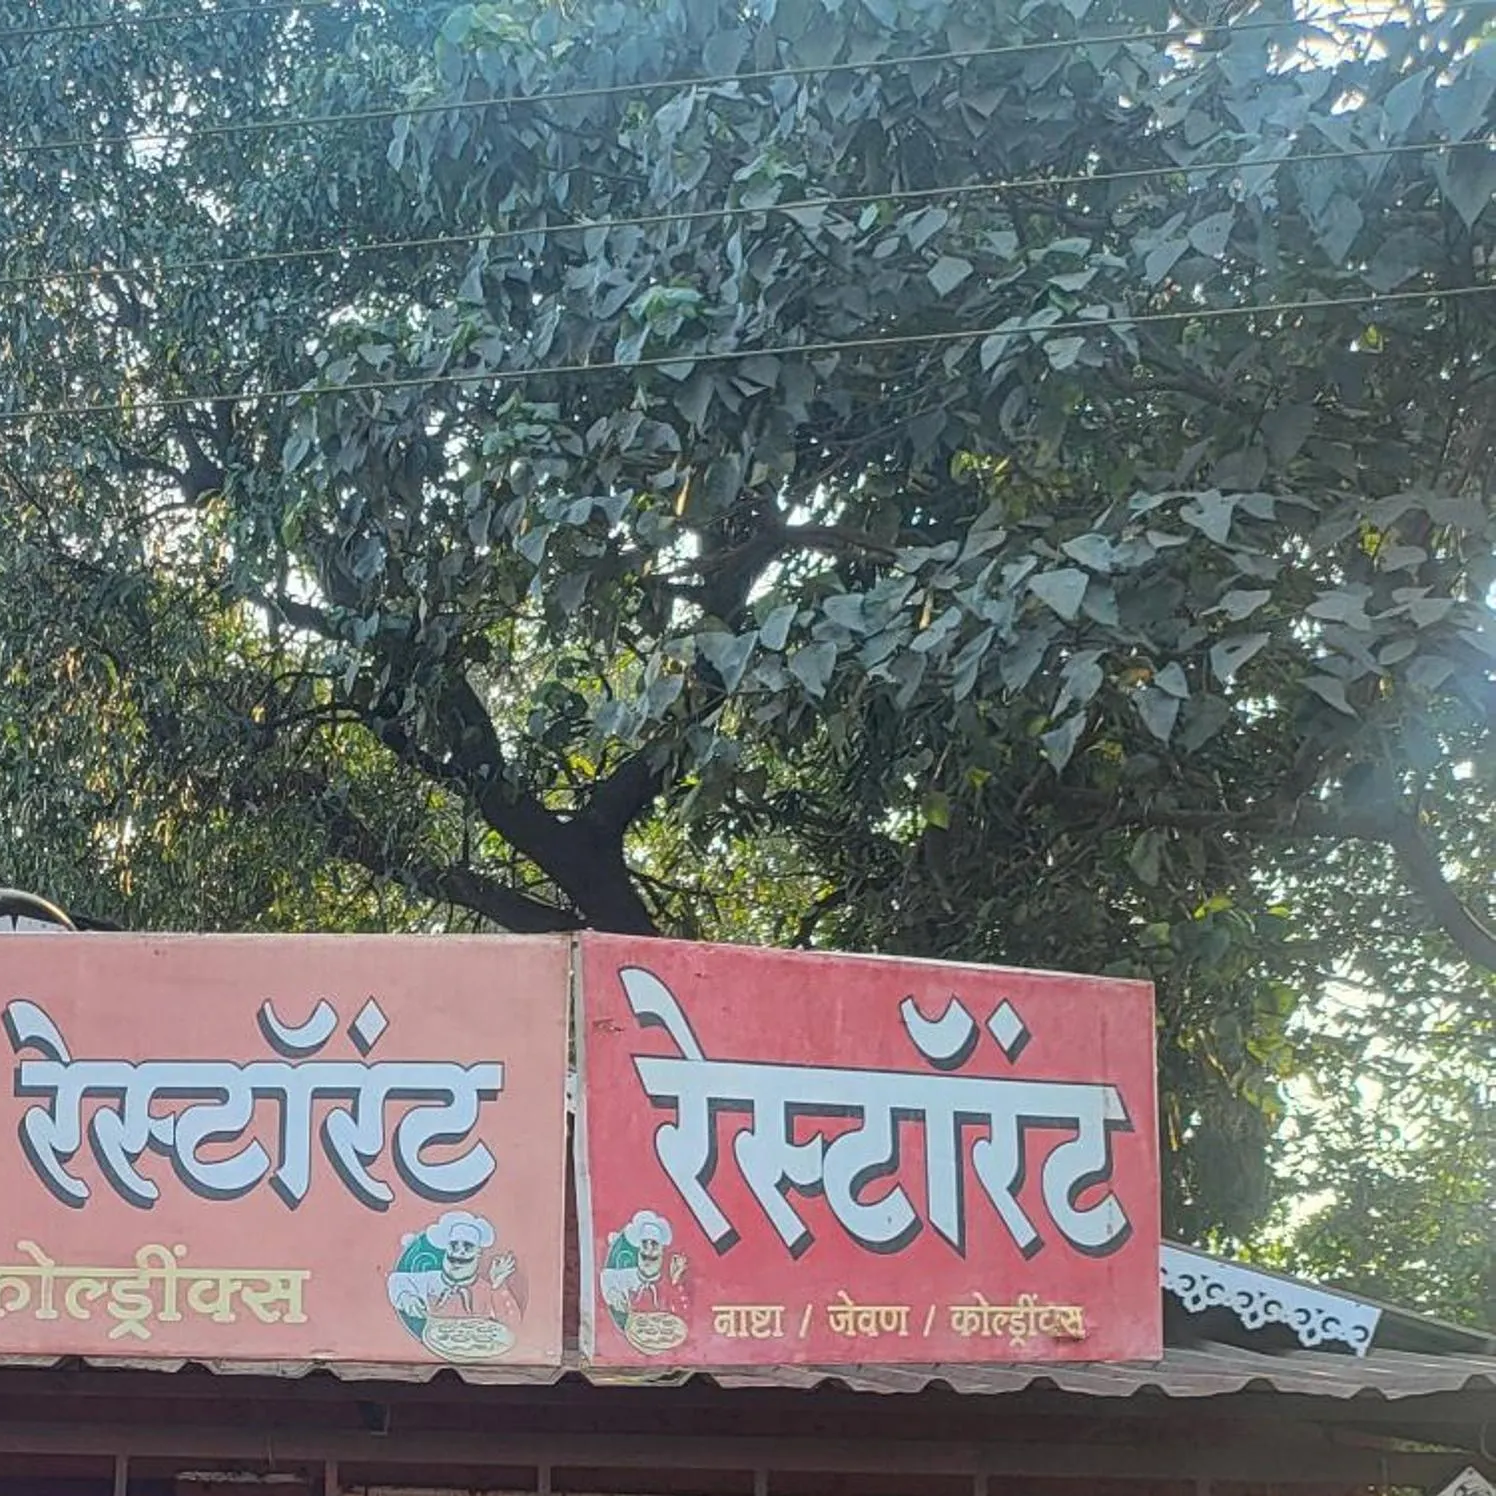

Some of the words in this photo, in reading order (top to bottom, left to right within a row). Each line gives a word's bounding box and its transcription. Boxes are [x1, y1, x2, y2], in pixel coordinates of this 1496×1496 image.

[2, 996, 504, 1211] रेस्टॉरंट
[617, 965, 1136, 1261] रेस्टॉरंट
[711, 1305, 785, 1338] नाष्टा
[827, 1290, 910, 1338] जेवण
